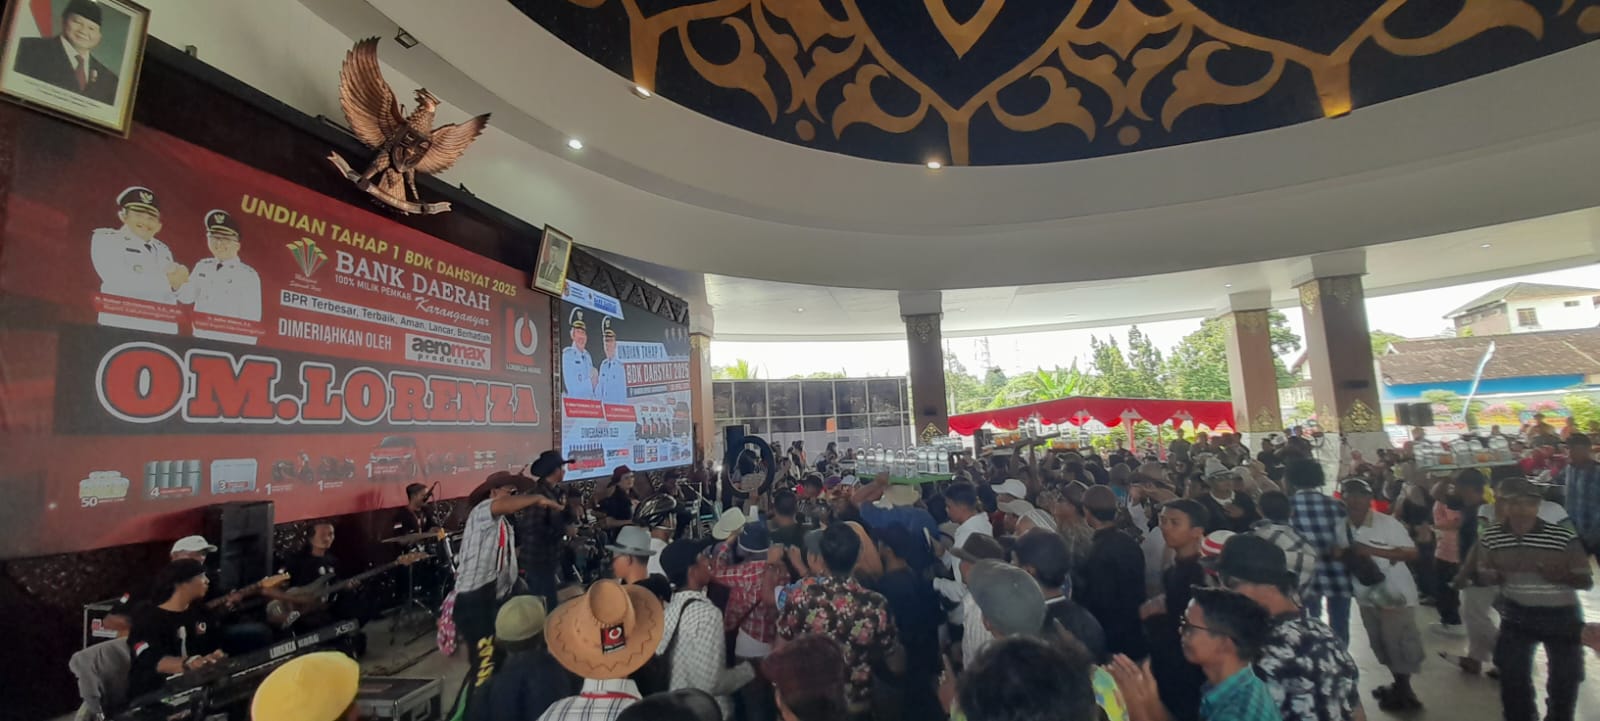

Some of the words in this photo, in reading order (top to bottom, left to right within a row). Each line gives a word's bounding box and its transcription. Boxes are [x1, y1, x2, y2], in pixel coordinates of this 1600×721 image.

[240, 194, 327, 237] UNDIAN
[330, 223, 388, 255] TAHAP
[393, 244, 400, 261] 1
[405, 250, 433, 271] BDK
[436, 261, 490, 290] DAHSYAT
[491, 278, 518, 298] 2025
[335, 250, 405, 288] BANK
[412, 272, 491, 311] DAERAH
[335, 274, 355, 287] 100%
[357, 279, 379, 293] MILIK
[282, 291, 308, 306] BPR
[312, 297, 358, 318] Terbesar,
[362, 308, 398, 325] Terbaik,
[428, 323, 456, 337] Lancar,
[415, 296, 489, 327] Karanganyar
[277, 318, 362, 345] DIMERIAHKAN
[366, 332, 392, 351] OLEH
[411, 337, 486, 363] aeromax
[418, 354, 482, 367] production
[626, 364, 642, 383] BDK
[364, 463, 373, 478] 1
[150, 487, 160, 497] 4
[264, 483, 272, 495] 1
[80, 497, 97, 508] 50
